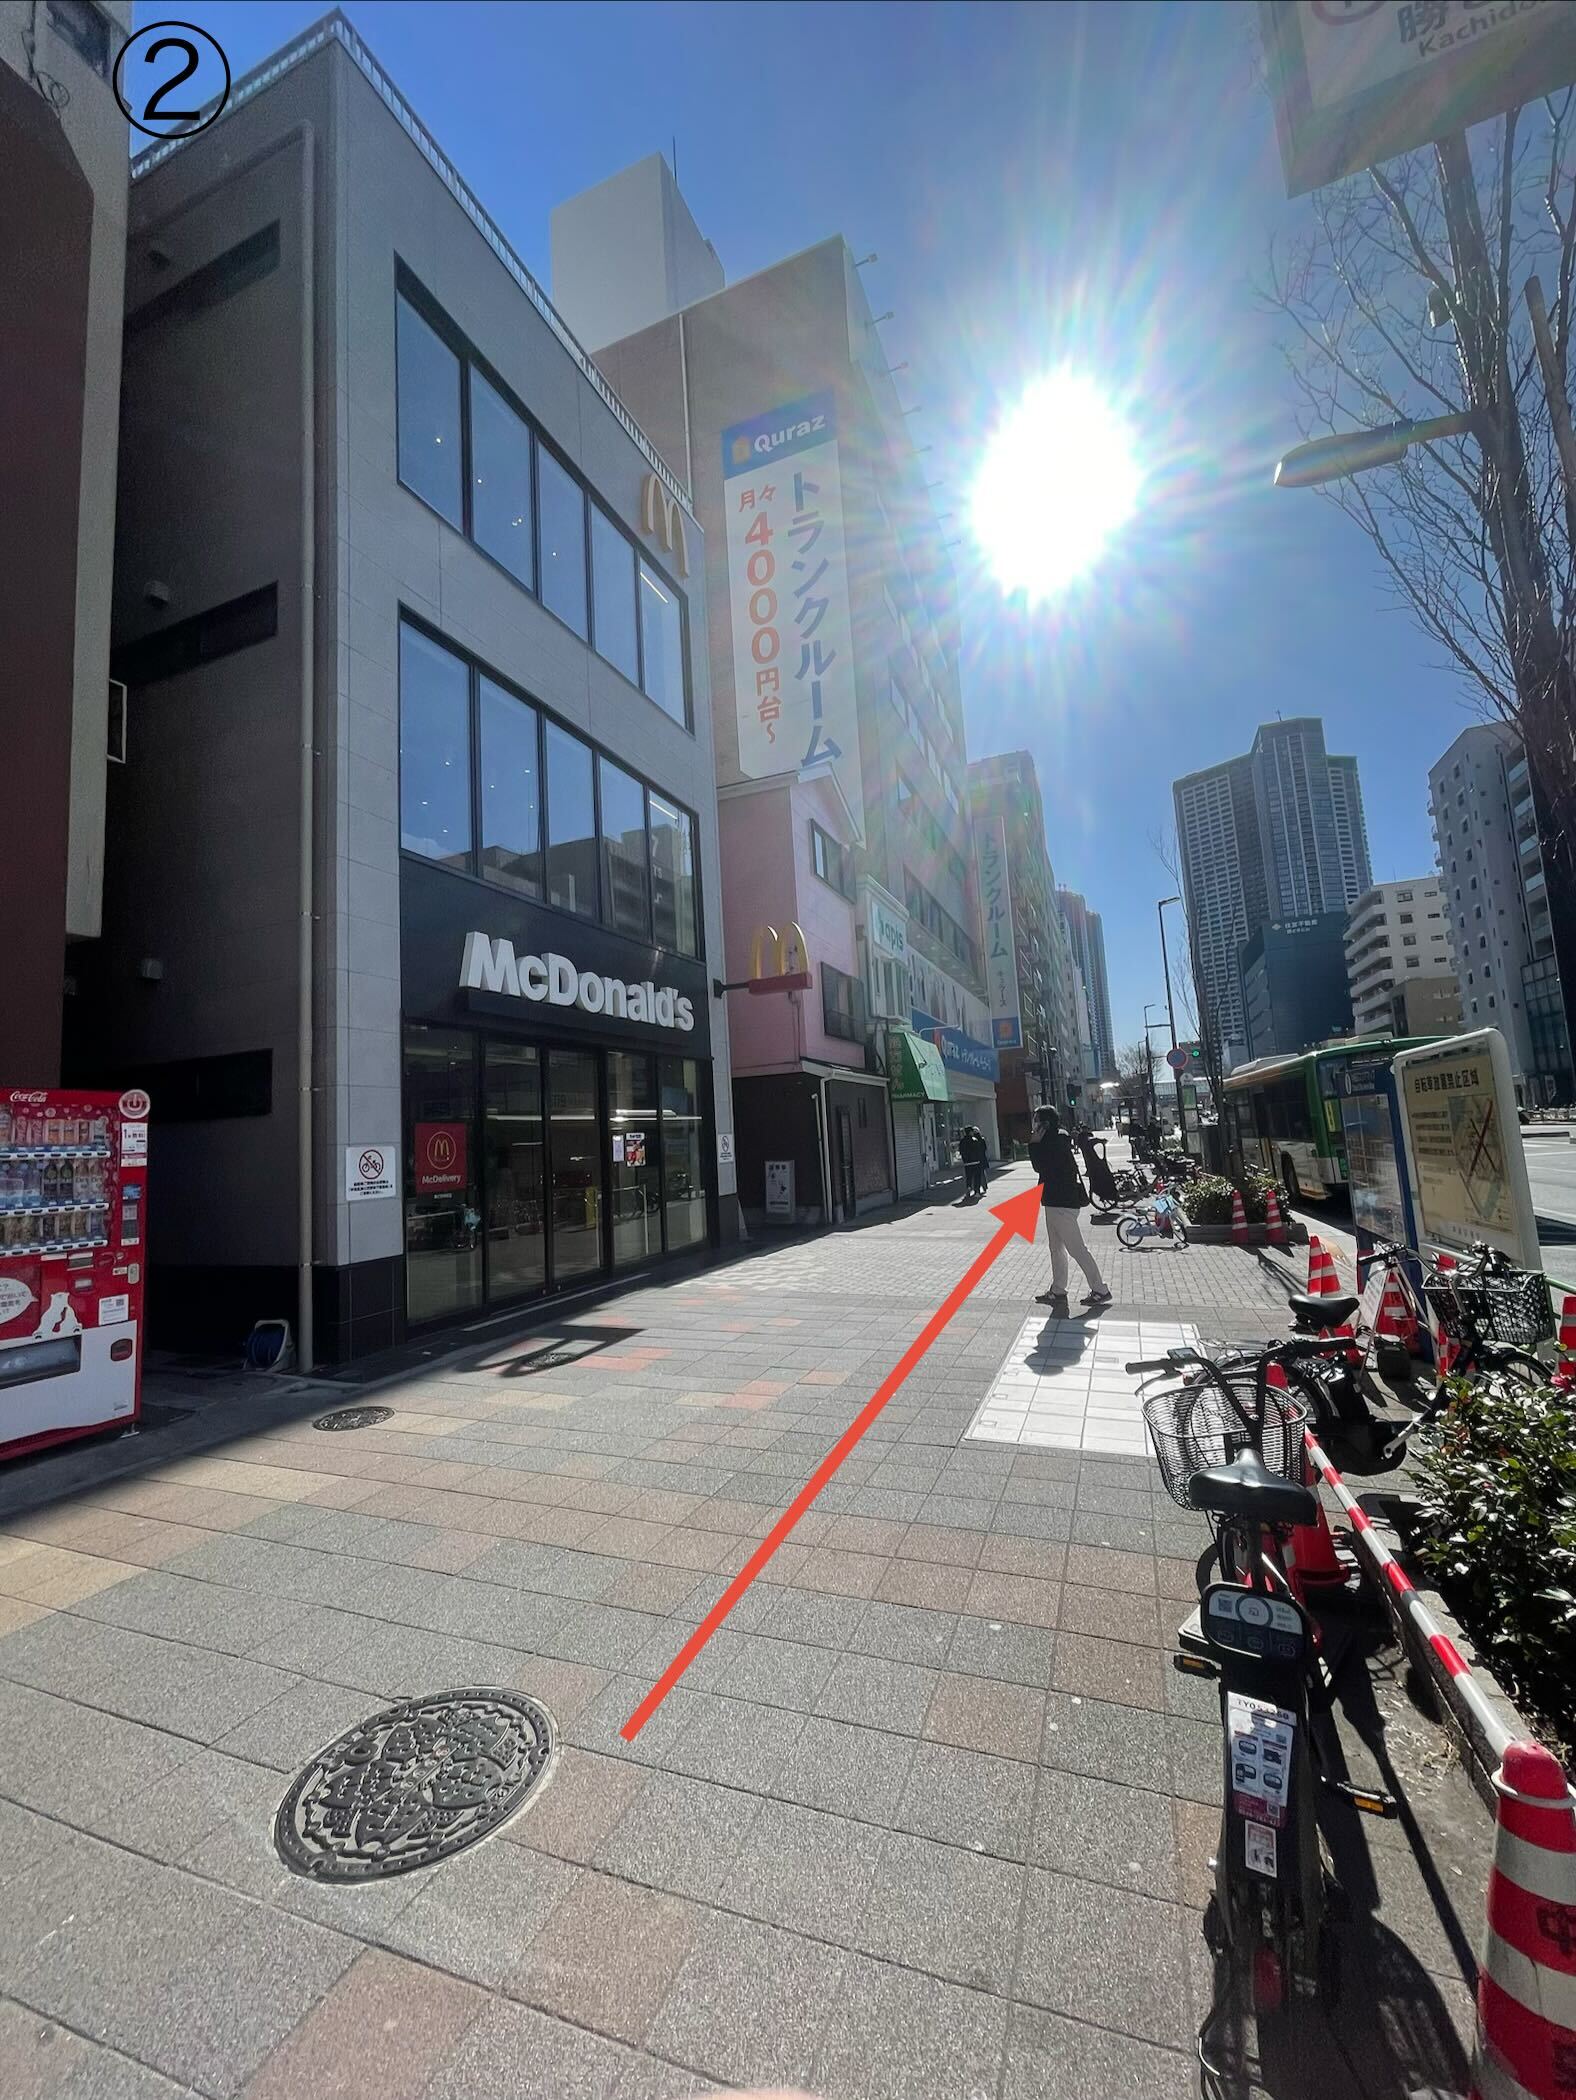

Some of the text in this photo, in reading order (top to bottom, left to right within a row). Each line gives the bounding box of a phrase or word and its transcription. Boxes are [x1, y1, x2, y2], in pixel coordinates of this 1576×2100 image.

[1419, 1, 1546, 57] Kachido
[754, 411, 826, 455] Quraz
[787, 471, 842, 768] トランクルーム
[983, 833, 1008, 958] トランクルーム
[459, 930, 695, 1032] McDonald's
[10, 1090, 48, 1103] Coca-Cola
[422, 1174, 462, 1185] McDelivery
